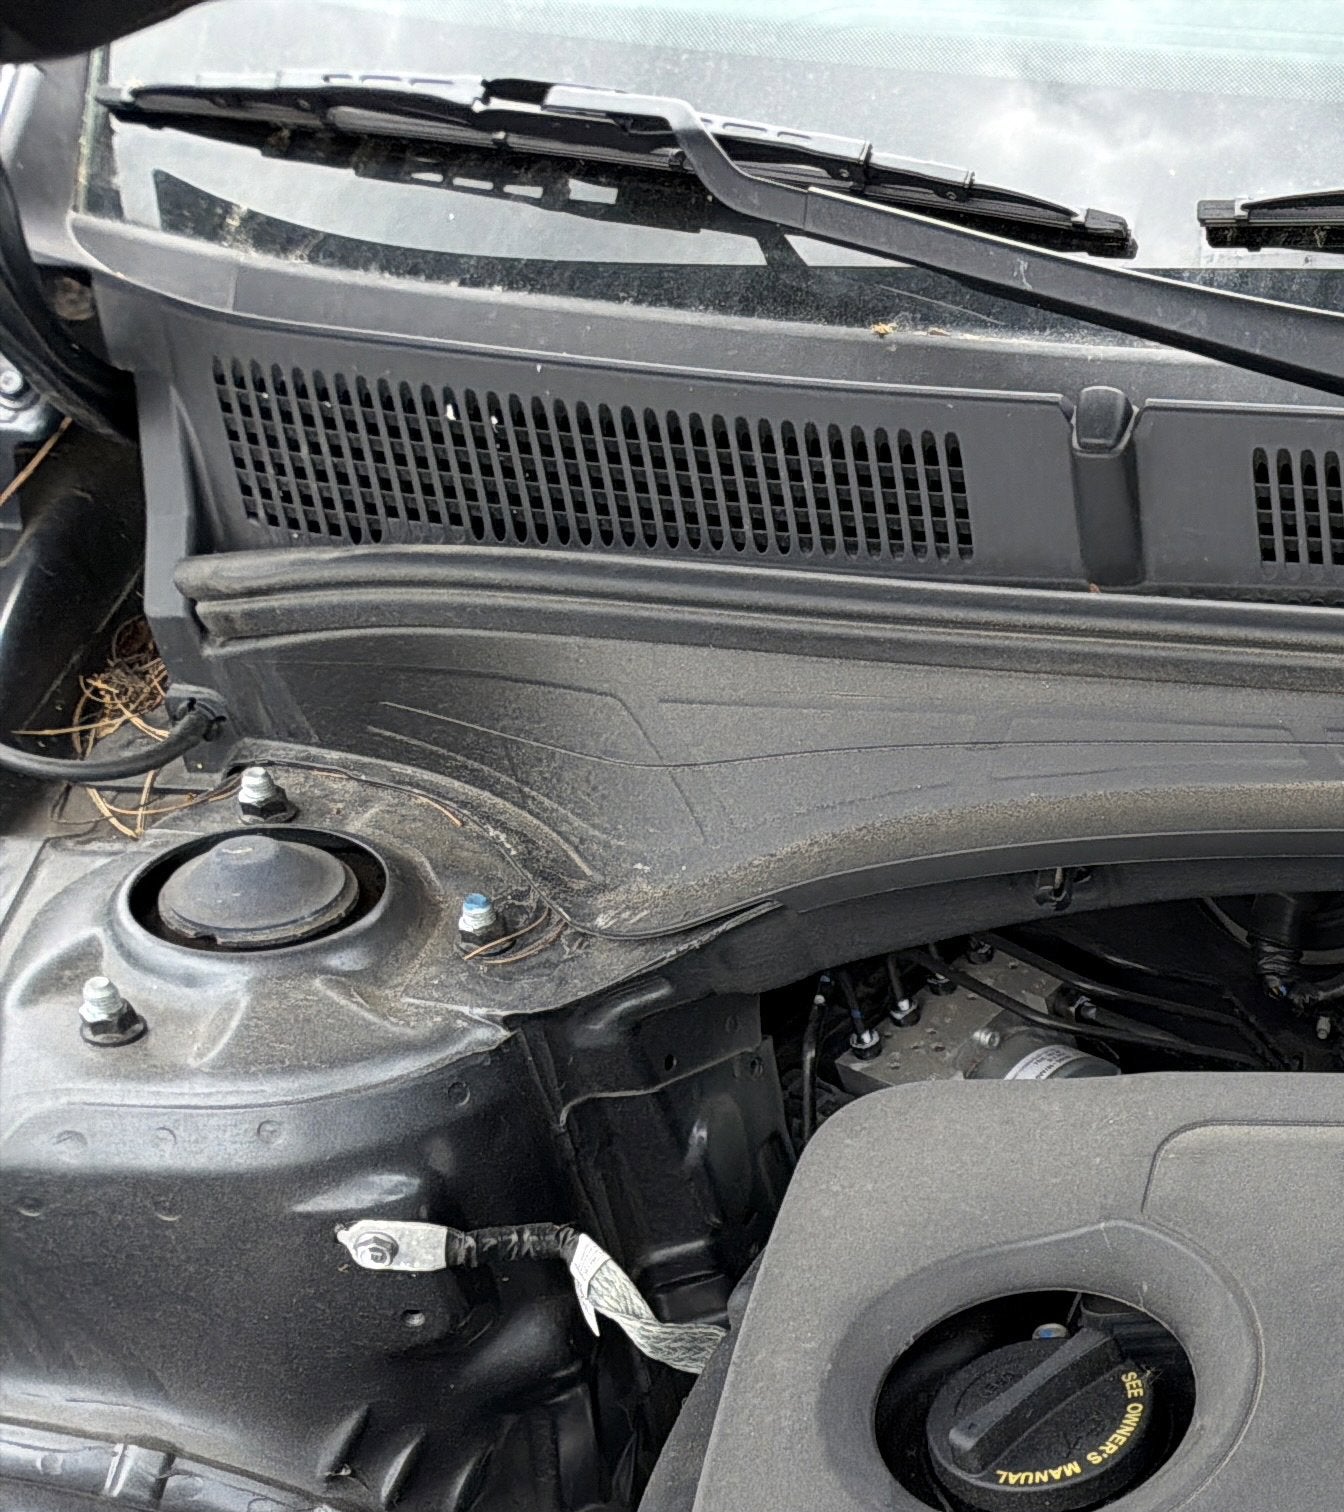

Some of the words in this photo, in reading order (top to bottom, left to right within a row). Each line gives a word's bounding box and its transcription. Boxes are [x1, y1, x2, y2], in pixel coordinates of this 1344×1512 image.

[1121, 1370, 1144, 1399] SEE
[1086, 1402, 1144, 1466] OWNER'S
[996, 1460, 1082, 1486] MANUAL
